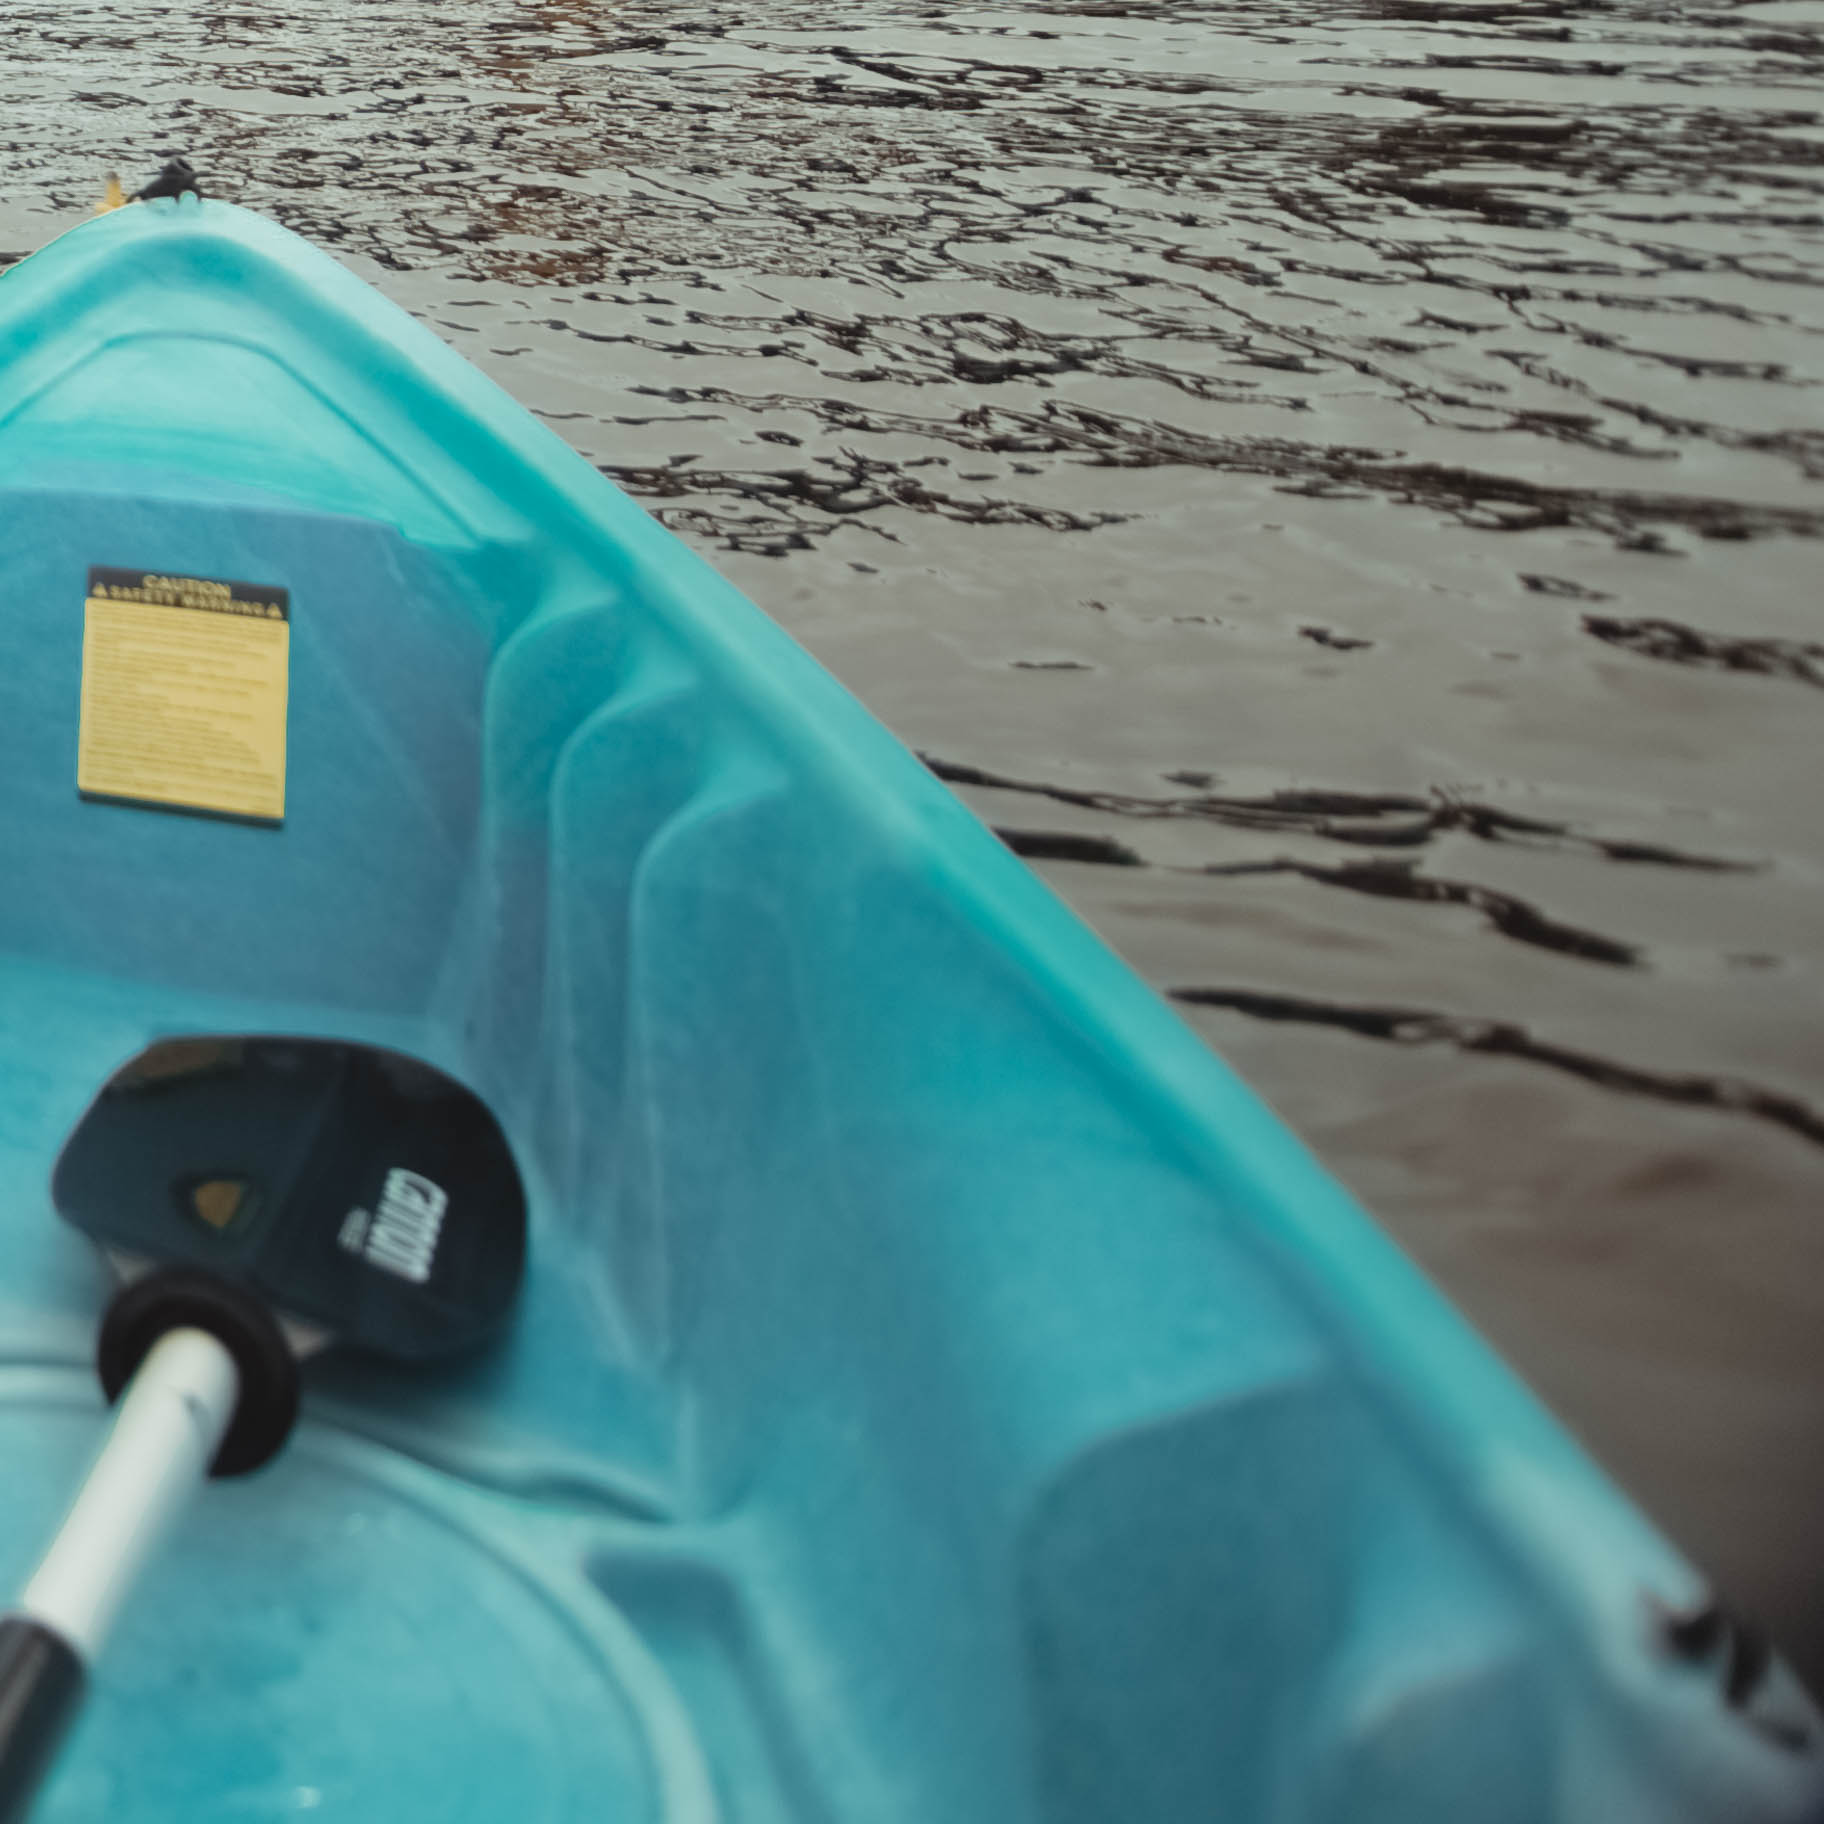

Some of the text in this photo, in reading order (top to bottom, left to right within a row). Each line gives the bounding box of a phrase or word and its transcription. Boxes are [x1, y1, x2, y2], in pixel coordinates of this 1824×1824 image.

[109, 584, 264, 616] SAFETY WARNING
[142, 575, 232, 600] CAUTION
